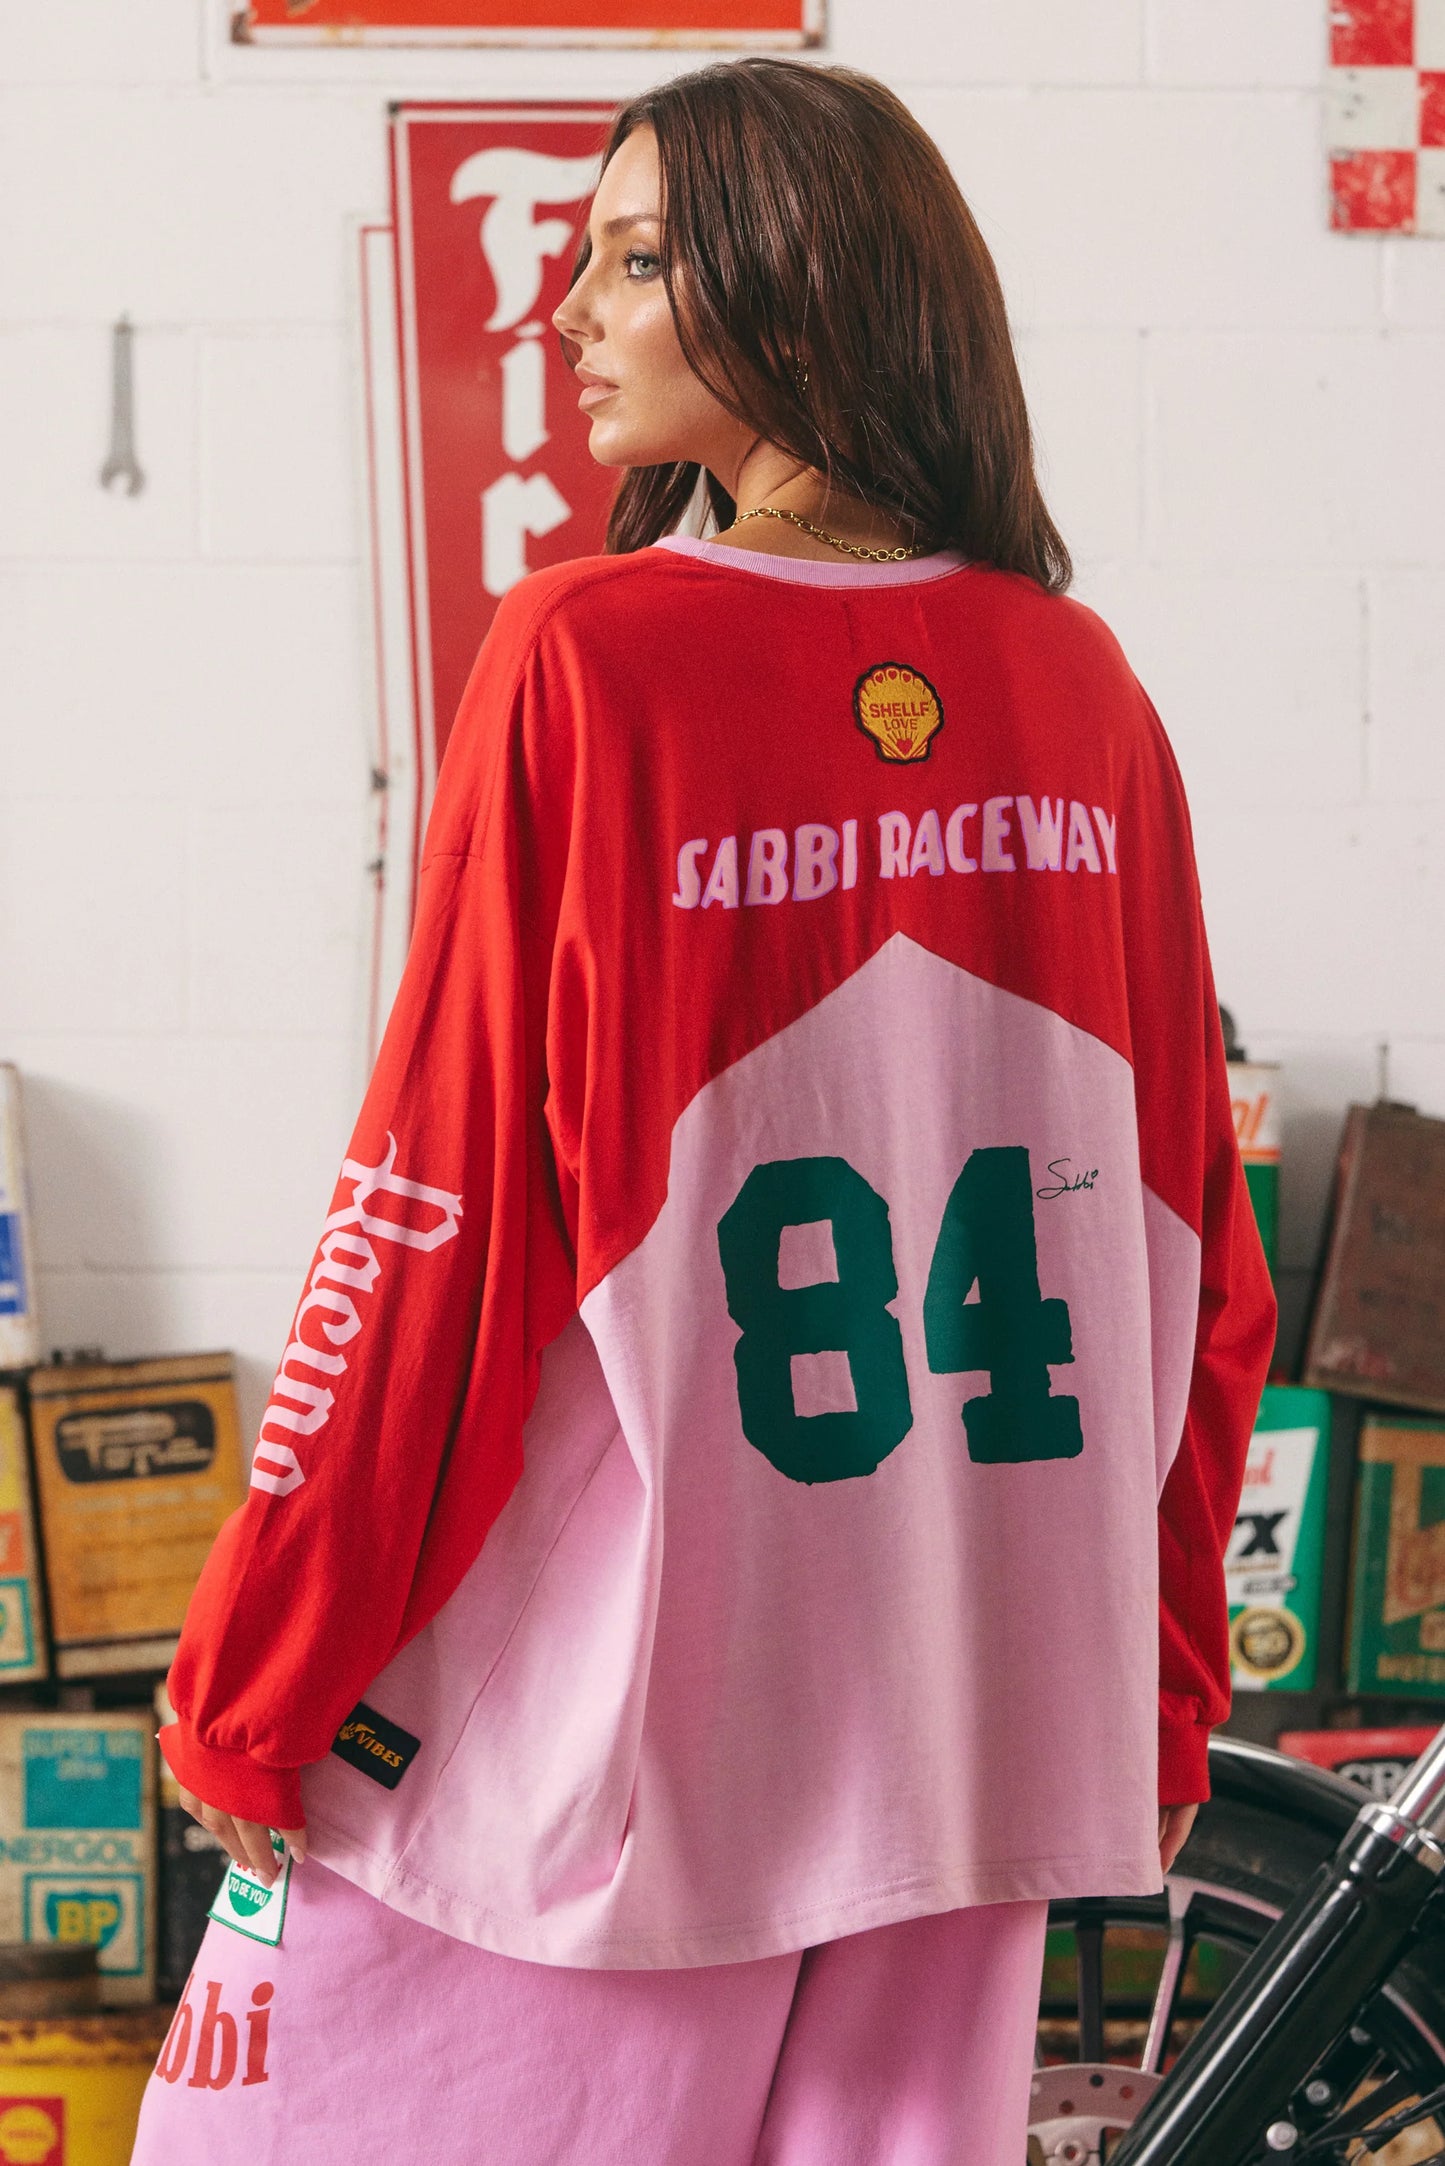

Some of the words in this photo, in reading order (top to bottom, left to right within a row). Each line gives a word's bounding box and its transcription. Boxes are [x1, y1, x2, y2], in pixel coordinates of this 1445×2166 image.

[868, 701, 930, 719] SHELLF
[883, 718, 918, 732] LOVE
[672, 812, 858, 910] SABBI
[877, 795, 1117, 879] RACEWAY
[716, 1145, 1085, 1487] 84
[357, 1731, 404, 1768] VIBES
[228, 1876, 240, 1893] TO
[239, 1882, 252, 1898] BE
[249, 1886, 269, 1907] YOU
[57, 1900, 119, 1943] BP
